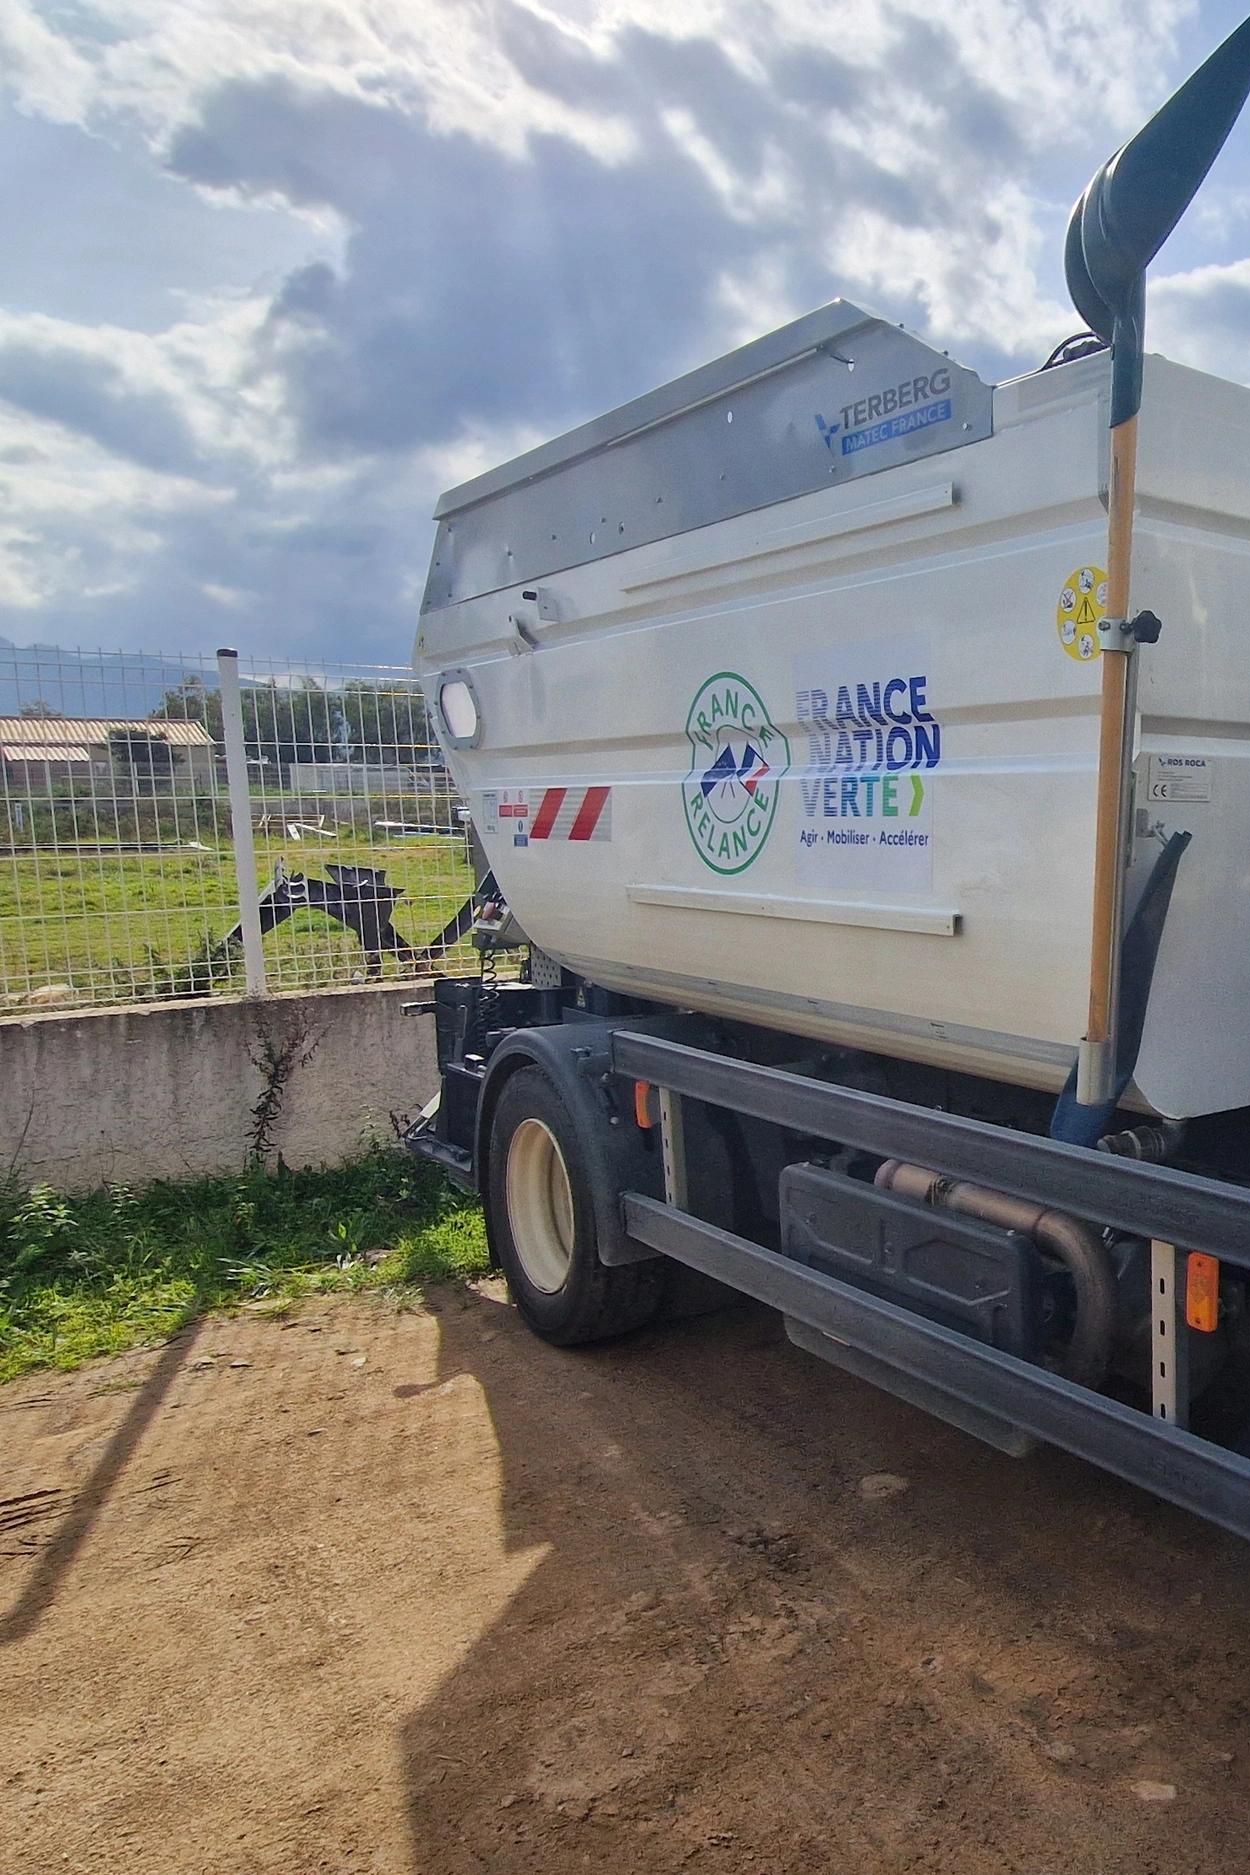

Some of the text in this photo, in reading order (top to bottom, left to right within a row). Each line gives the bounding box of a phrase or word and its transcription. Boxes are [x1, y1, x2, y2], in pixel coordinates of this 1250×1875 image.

[840, 368, 950, 429] TERBERG
[846, 406, 948, 452] MATEC FRANCE
[694, 688, 775, 751] FRANCE
[796, 676, 935, 732] FRANCE
[801, 724, 941, 773] NATION
[1167, 758, 1206, 767] ROS ROCA
[801, 772, 899, 817] VERTE
[690, 790, 769, 860] RELANCE
[800, 830, 930, 847] Agir Mobiliser Accélérer
